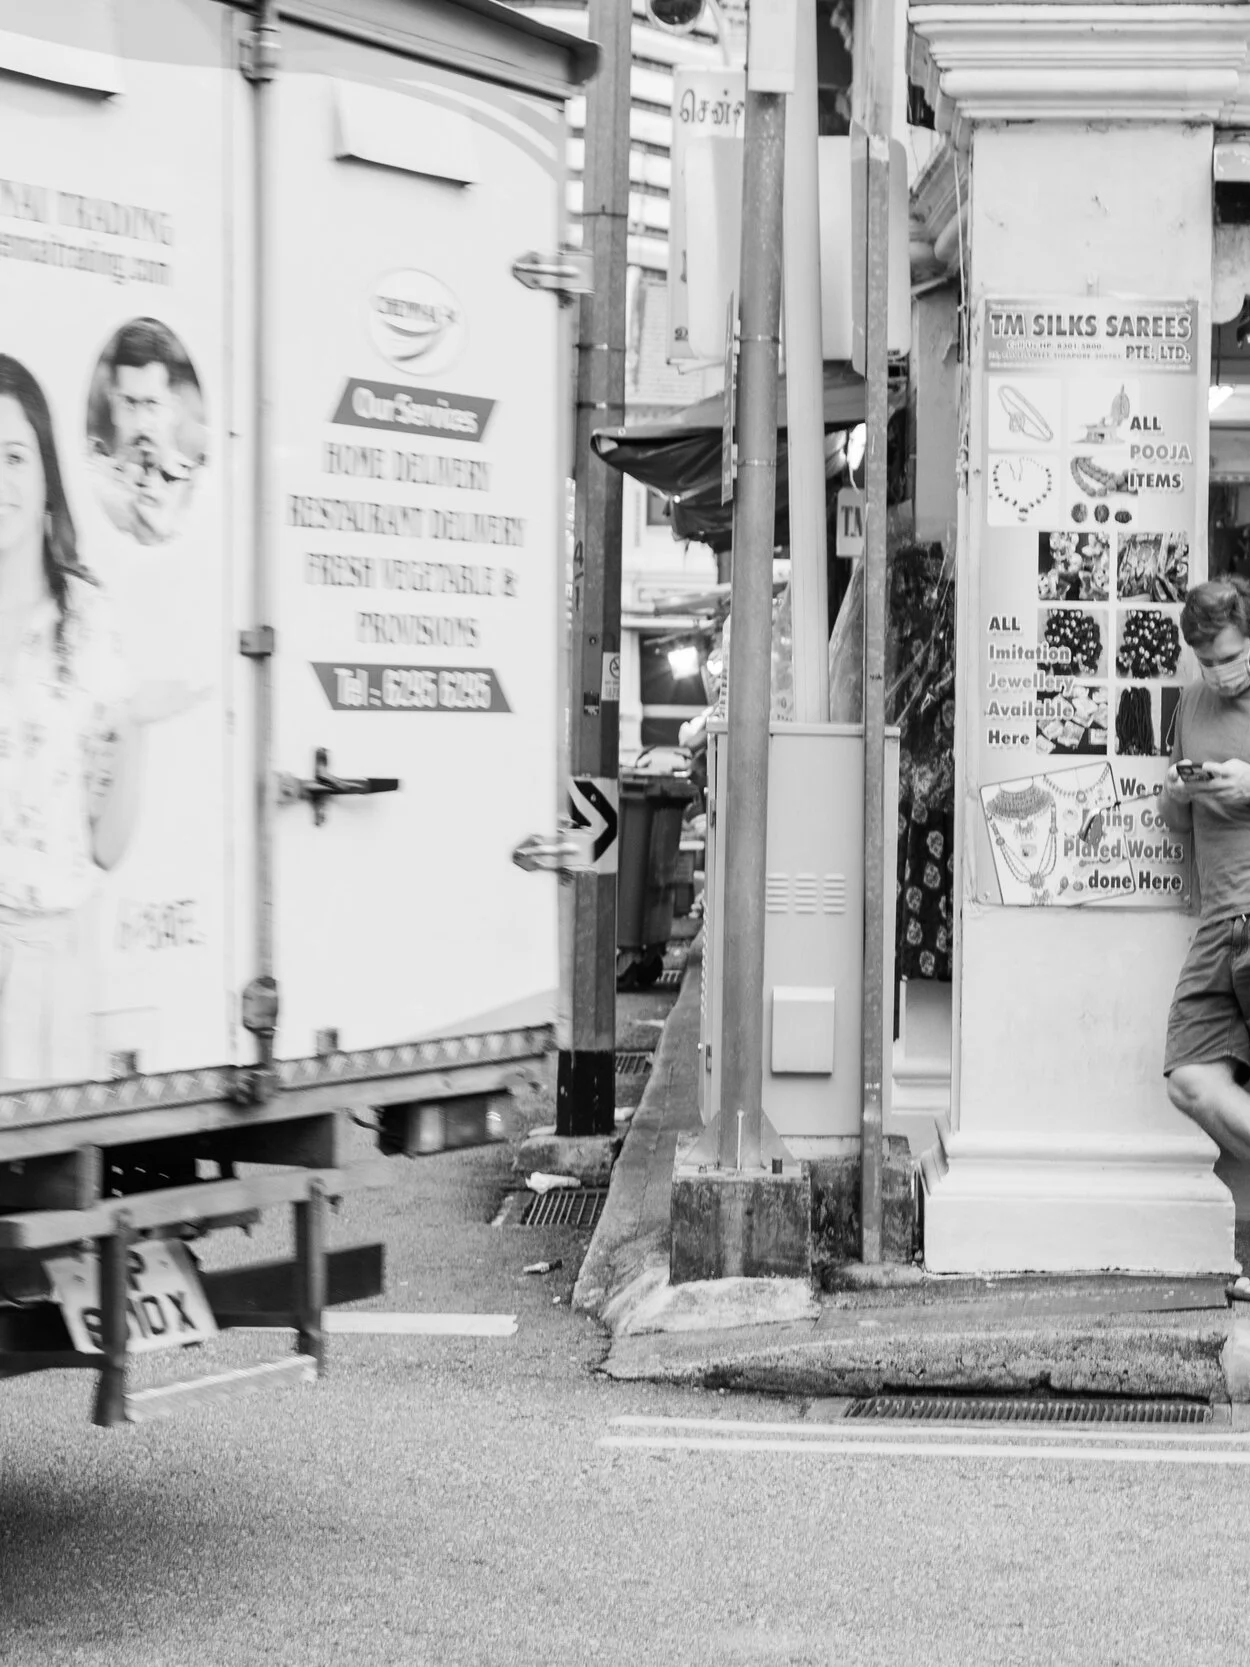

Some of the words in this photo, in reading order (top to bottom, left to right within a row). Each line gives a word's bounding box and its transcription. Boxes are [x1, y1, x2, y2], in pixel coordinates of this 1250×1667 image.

[991, 314, 1025, 336] TM
[1032, 314, 1098, 337] SILKS
[1105, 315, 1191, 338] SAREES
[1129, 416, 1162, 431] ALL
[1129, 444, 1191, 460] POOJA
[322, 441, 386, 480] HOME
[391, 449, 492, 492] DELIVERY
[1129, 472, 1182, 489] ITEMS
[285, 493, 423, 538] RESTAURANT
[428, 508, 527, 548] DELIVERY
[304, 551, 377, 589] FRESH
[379, 557, 498, 597] VEGETABLE
[355, 610, 481, 648] PROVISIONS
[988, 616, 1021, 632] ALL
[988, 644, 1072, 661] Imitation
[987, 672, 1075, 692] Jewellery
[987, 702, 1075, 718] Available
[988, 730, 1031, 746] Here
[1119, 777, 1147, 796] We
[1140, 808, 1166, 828] Go
[1127, 838, 1184, 859] Works
[1088, 868, 1132, 889] done
[1138, 871, 1183, 890] Here
